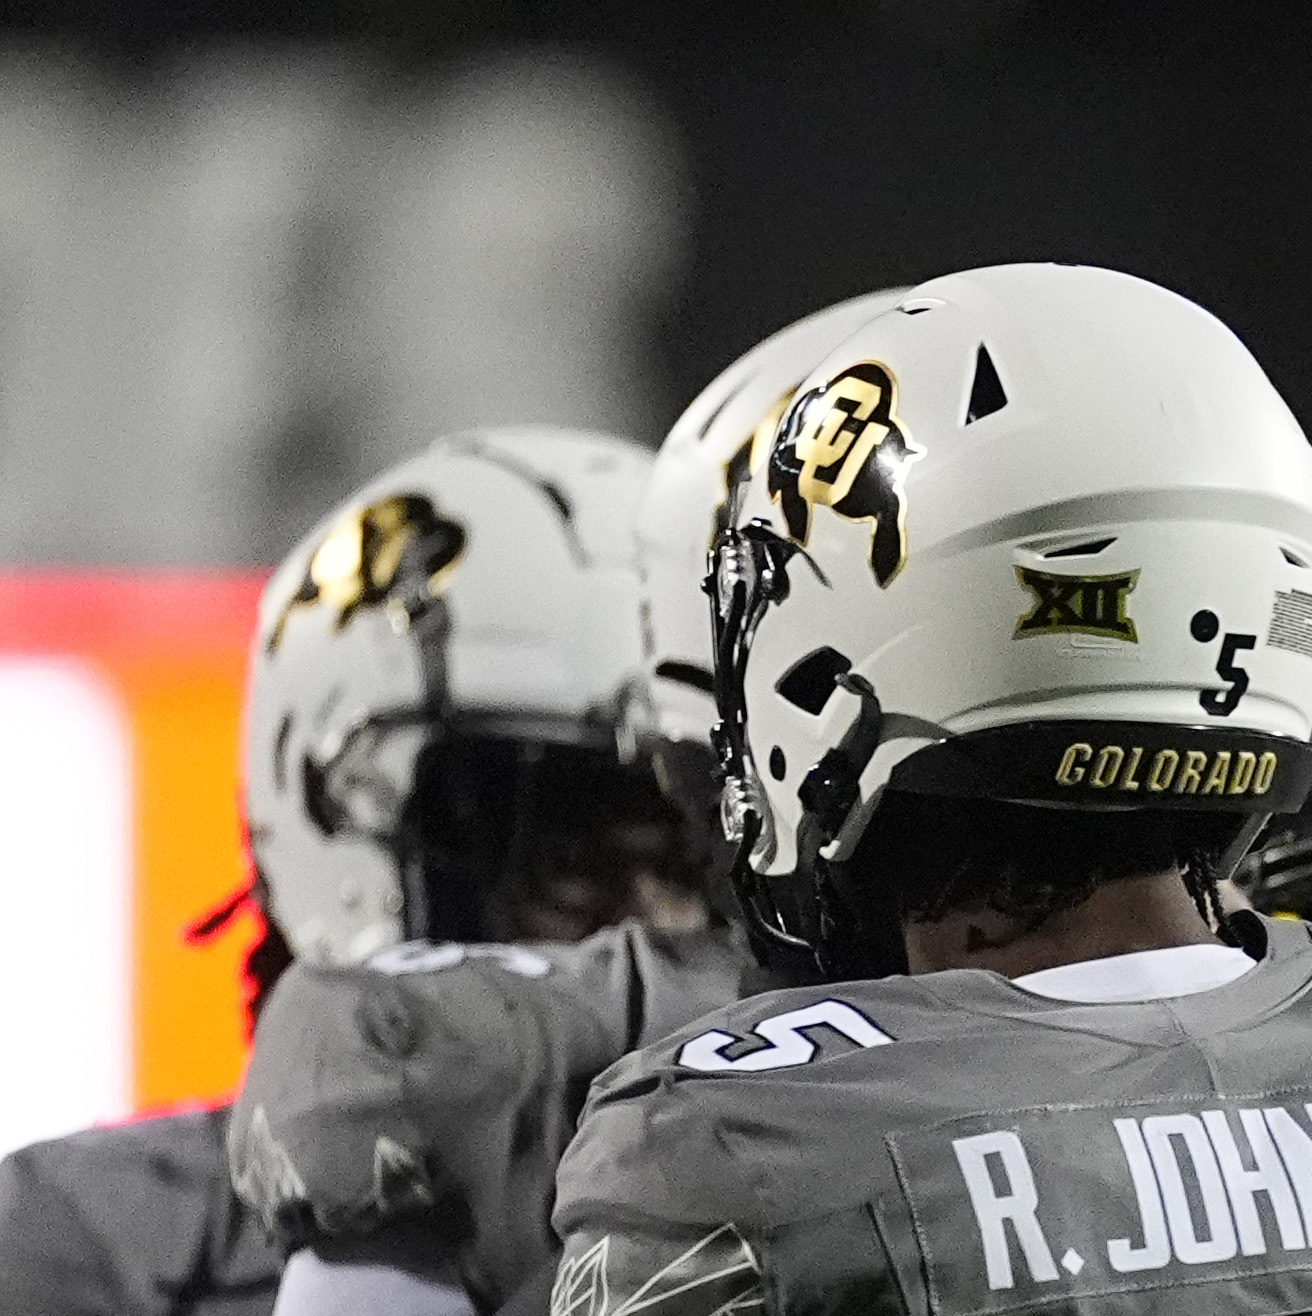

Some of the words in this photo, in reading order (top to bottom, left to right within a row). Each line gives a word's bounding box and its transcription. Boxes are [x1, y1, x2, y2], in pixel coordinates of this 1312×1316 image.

[1018, 572, 1133, 636] XII
[1199, 633, 1256, 717] 5
[1056, 743, 1278, 796] COLORADO
[675, 998, 898, 1072] 5
[952, 1130, 1085, 1291] R.
